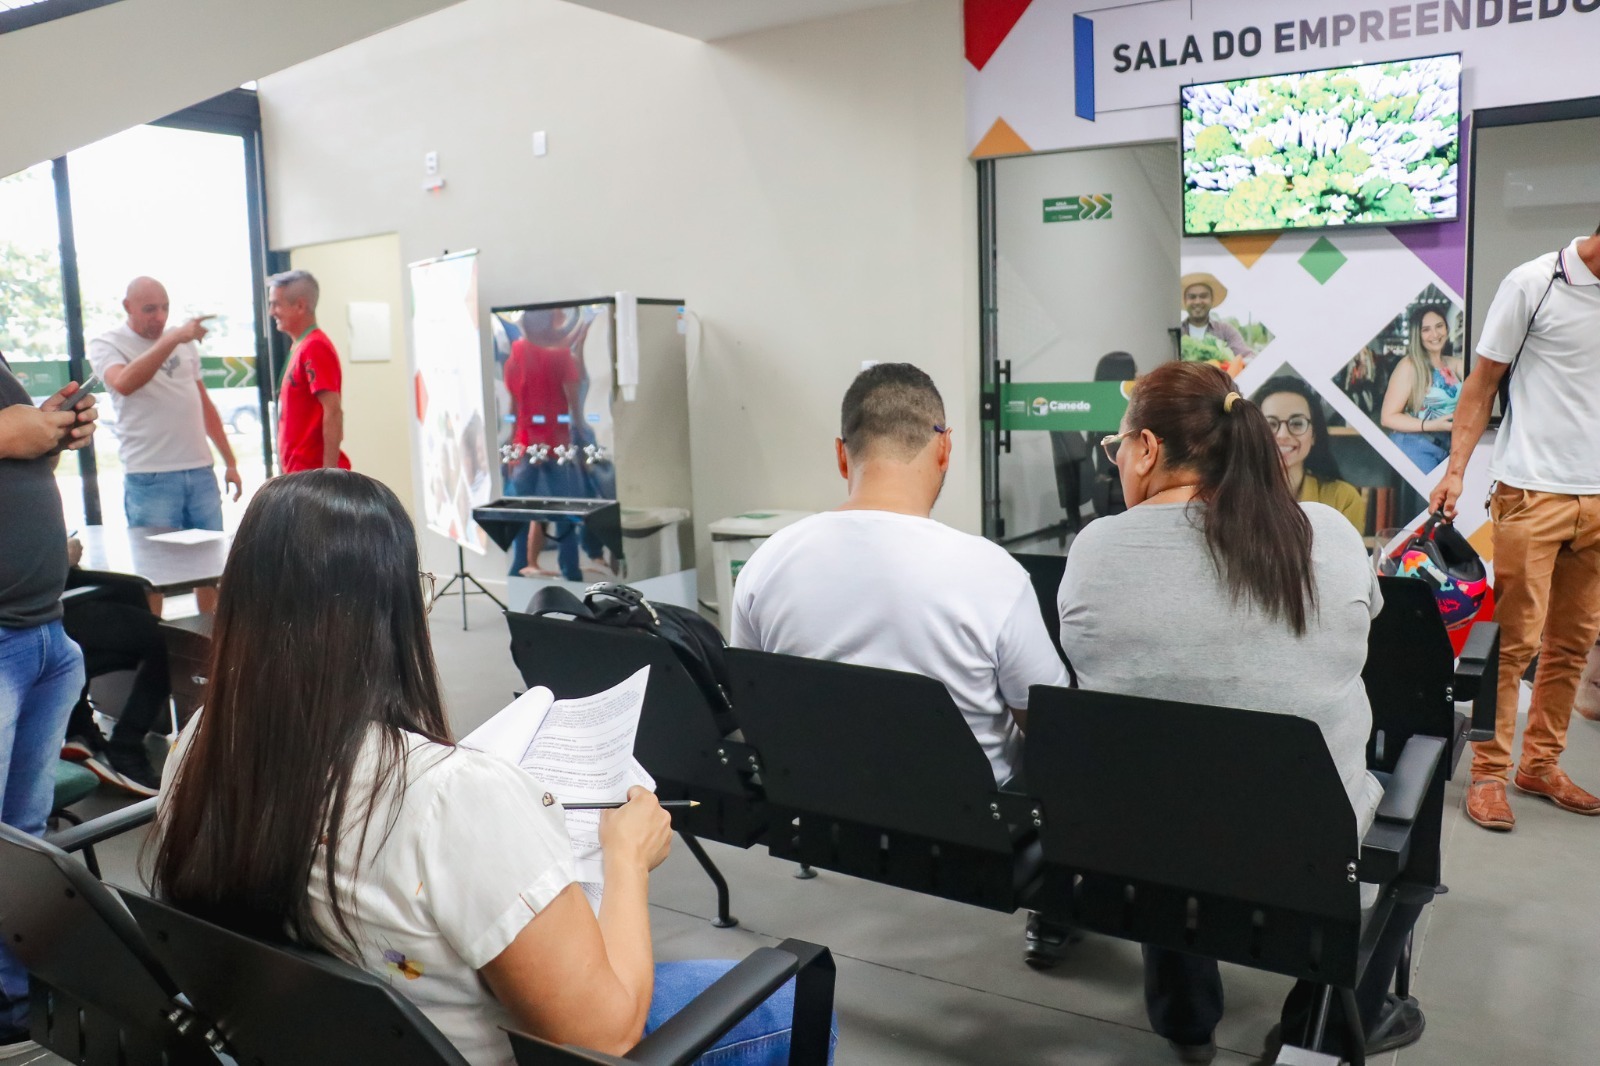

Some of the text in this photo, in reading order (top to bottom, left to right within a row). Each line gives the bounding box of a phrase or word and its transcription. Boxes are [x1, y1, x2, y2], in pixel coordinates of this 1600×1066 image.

[1113, 34, 1203, 73] SALA
[1213, 26, 1262, 61] DO
[1049, 400, 1091, 410] Canedo
